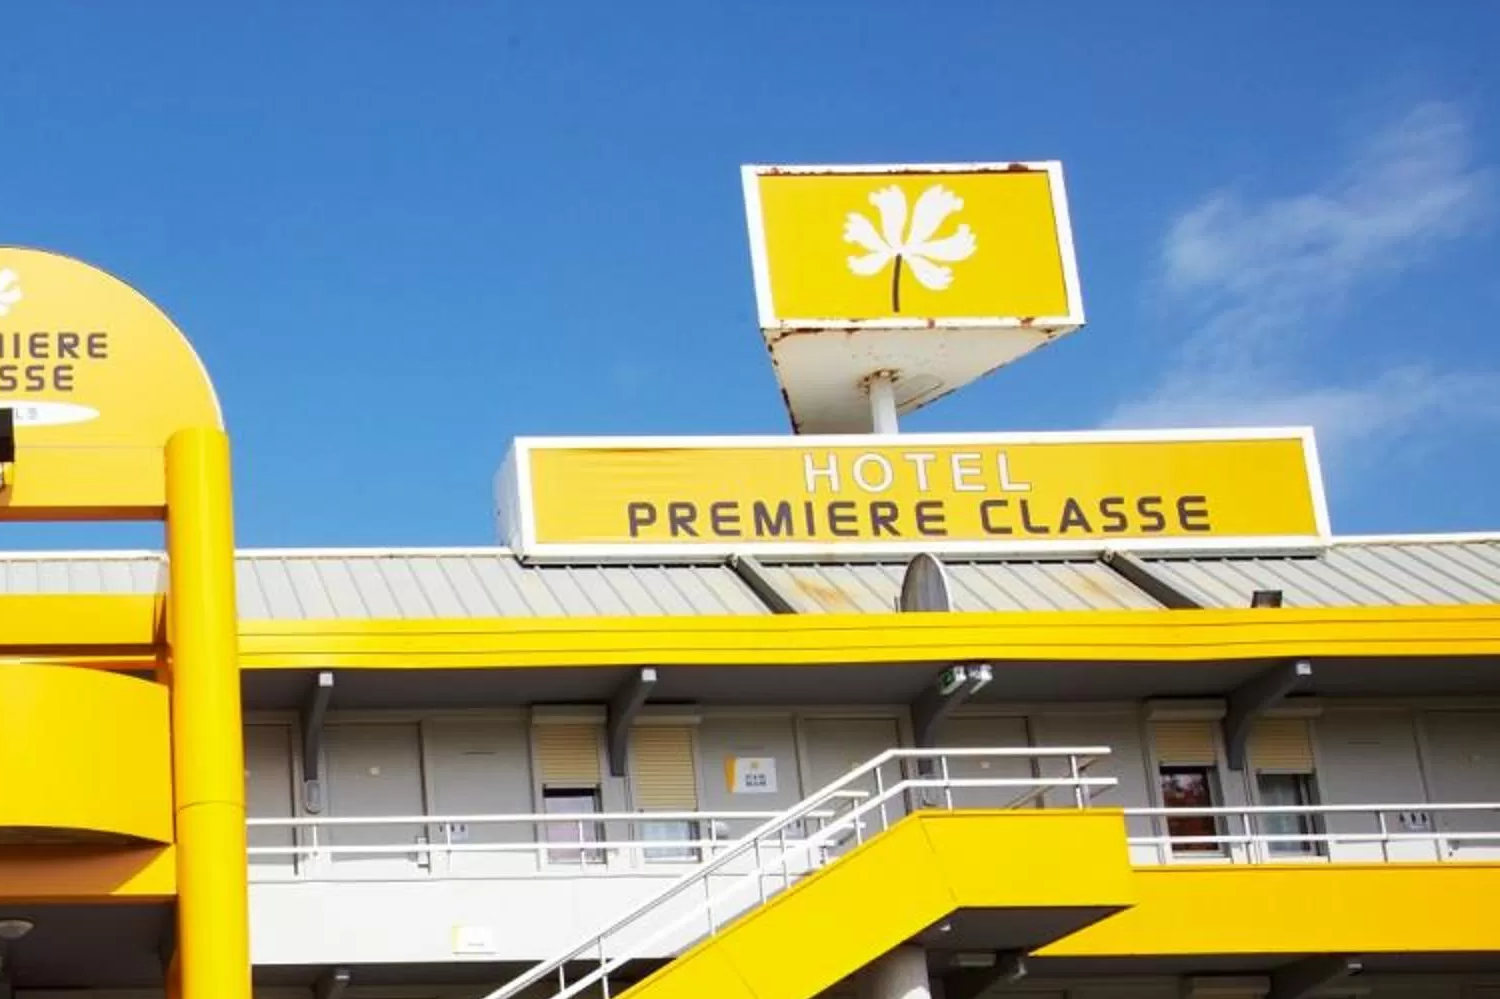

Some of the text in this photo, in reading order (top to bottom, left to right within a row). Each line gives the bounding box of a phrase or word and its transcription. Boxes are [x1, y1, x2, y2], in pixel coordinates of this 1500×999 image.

[802, 451, 1033, 493] HOTEL
[627, 494, 1211, 538] PREMIERE CLASSE
